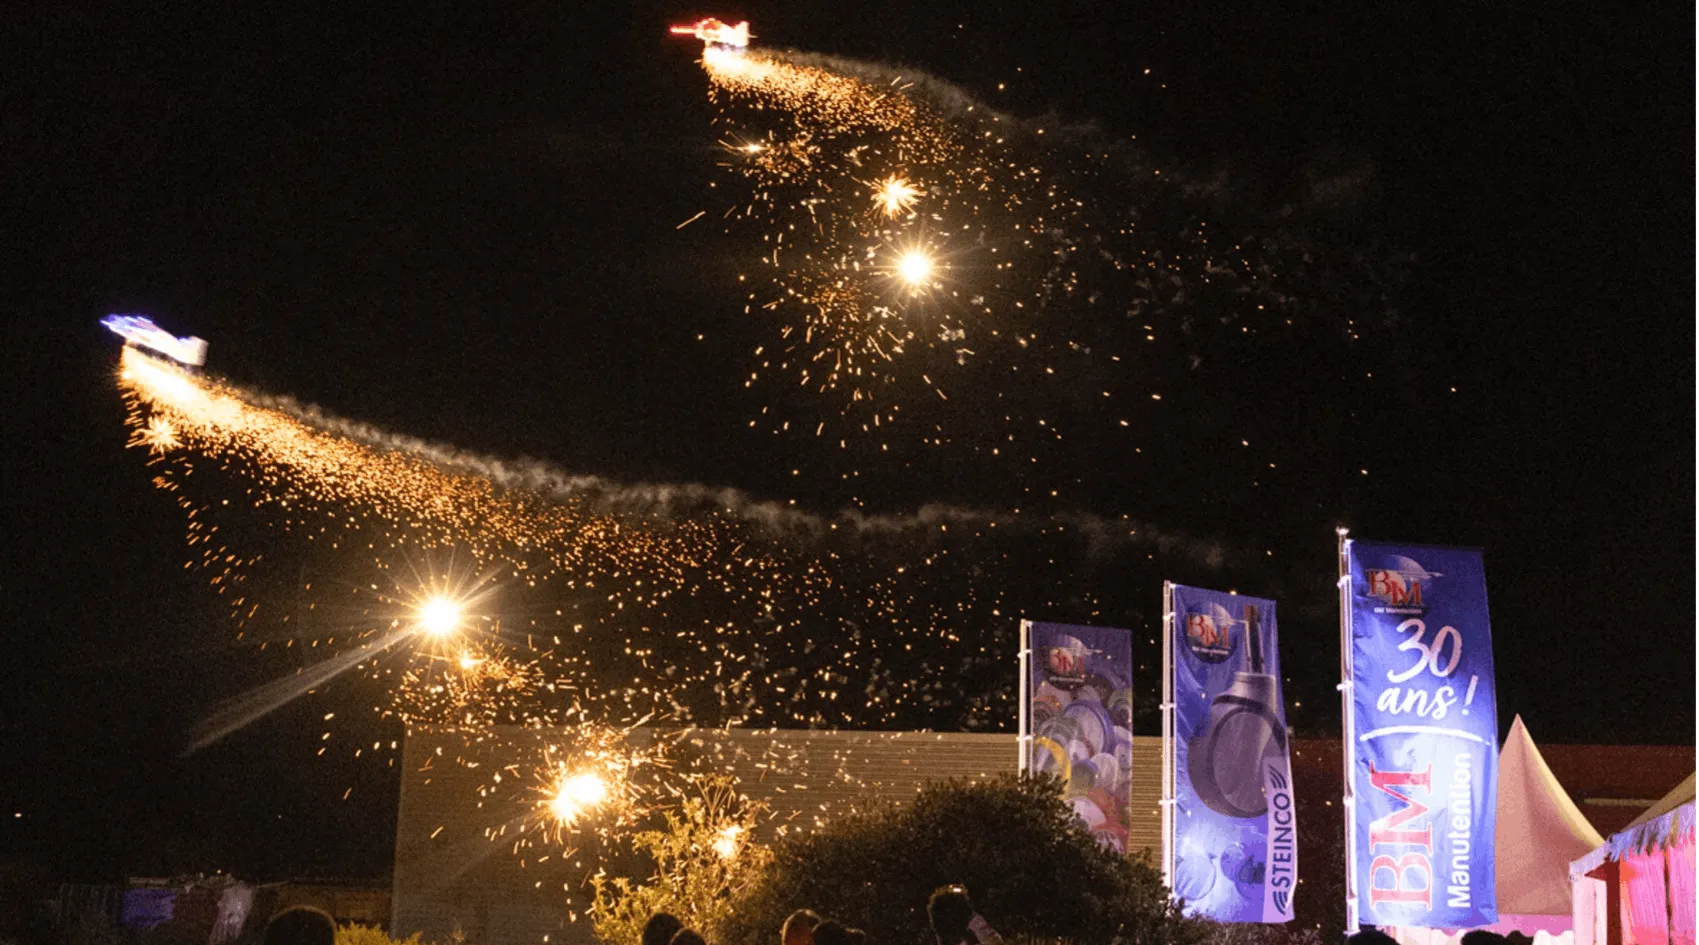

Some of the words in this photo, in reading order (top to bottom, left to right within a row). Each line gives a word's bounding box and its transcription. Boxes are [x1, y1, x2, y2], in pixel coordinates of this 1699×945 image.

[1367, 568, 1424, 606] BM
[1387, 618, 1462, 683] 30
[1271, 793, 1292, 888] STEINCO
[1369, 759, 1432, 911] BM
[1447, 752, 1471, 908] Manutention
